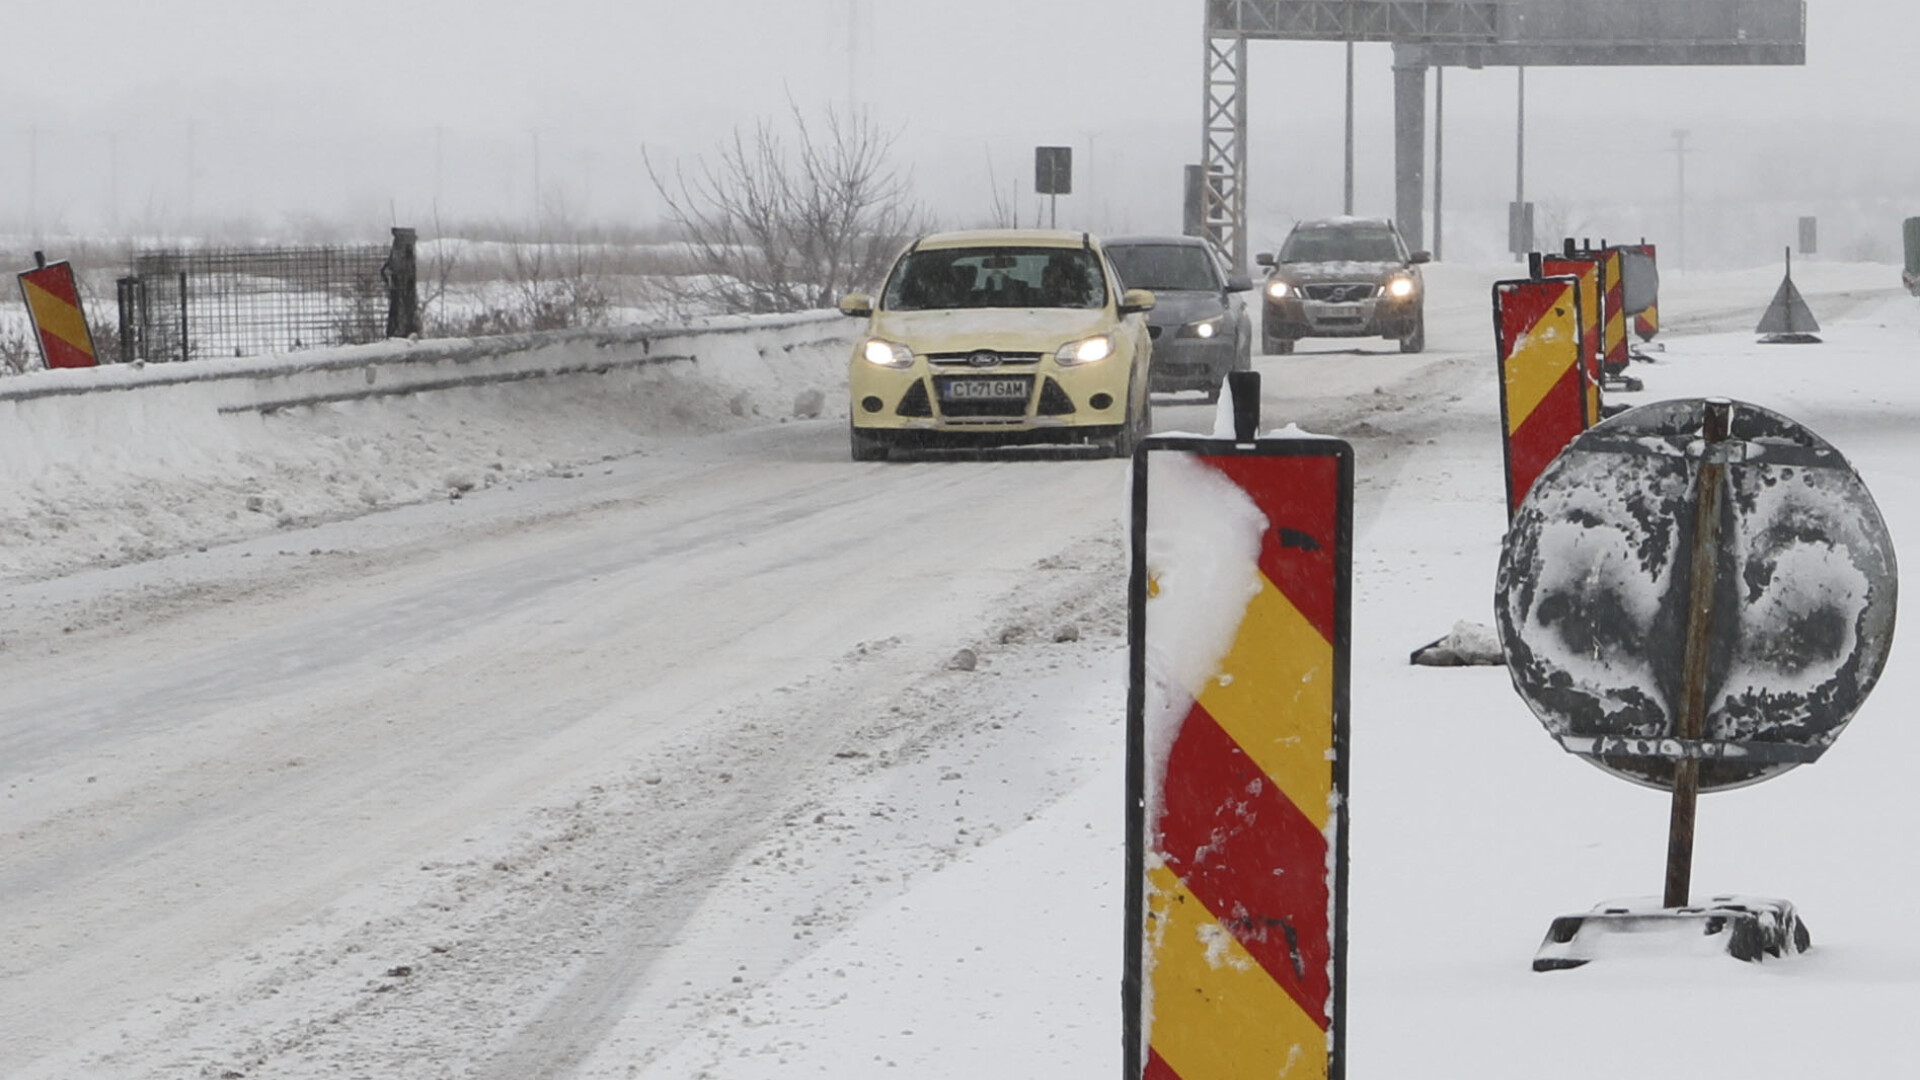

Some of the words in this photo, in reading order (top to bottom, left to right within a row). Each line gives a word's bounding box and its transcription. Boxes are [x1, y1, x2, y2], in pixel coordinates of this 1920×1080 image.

[953, 382, 972, 396] CT
[977, 382, 991, 396] 71
[994, 382, 1023, 396] GAM
